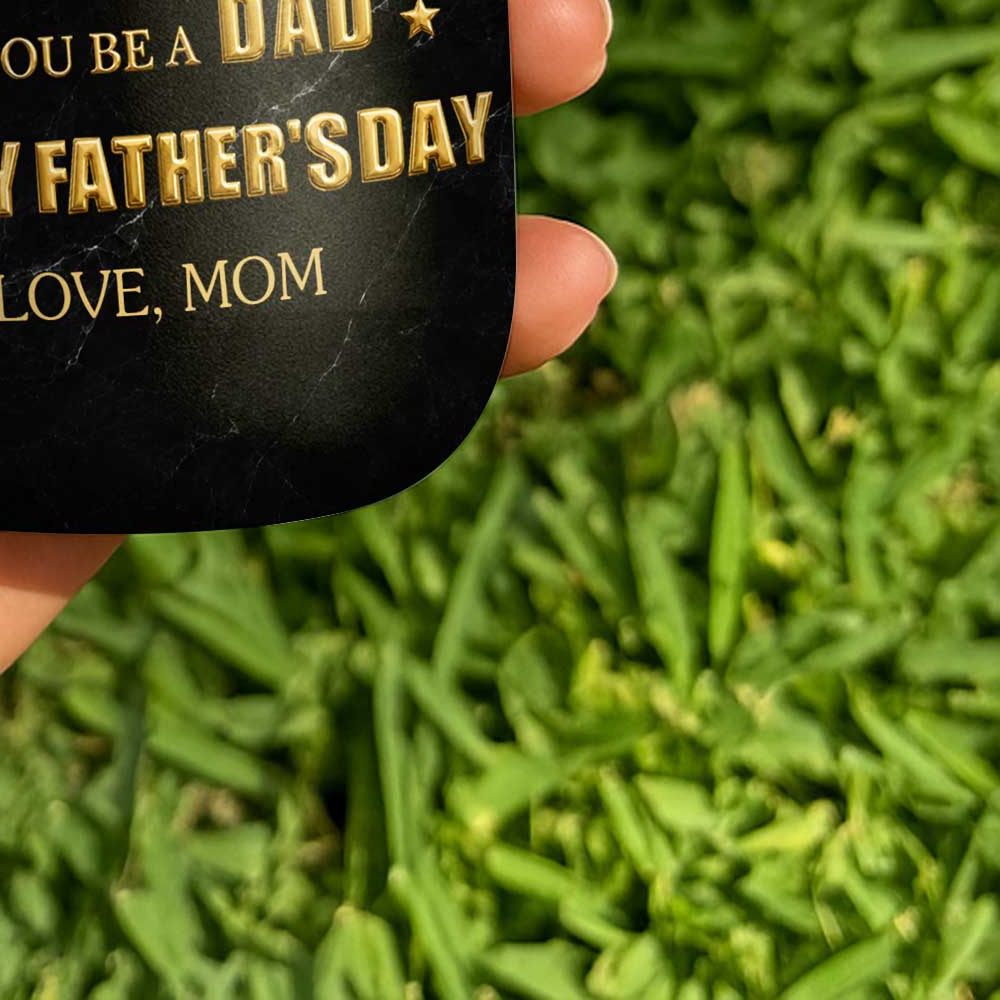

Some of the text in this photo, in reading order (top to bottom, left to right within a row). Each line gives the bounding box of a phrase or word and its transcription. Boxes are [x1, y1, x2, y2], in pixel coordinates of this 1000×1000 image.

[89, 28, 154, 73] BE
[166, 25, 200, 67] A
[35, 112, 353, 214] FATHER'S
[356, 92, 492, 183] DAY
[183, 248, 326, 311] MOM
